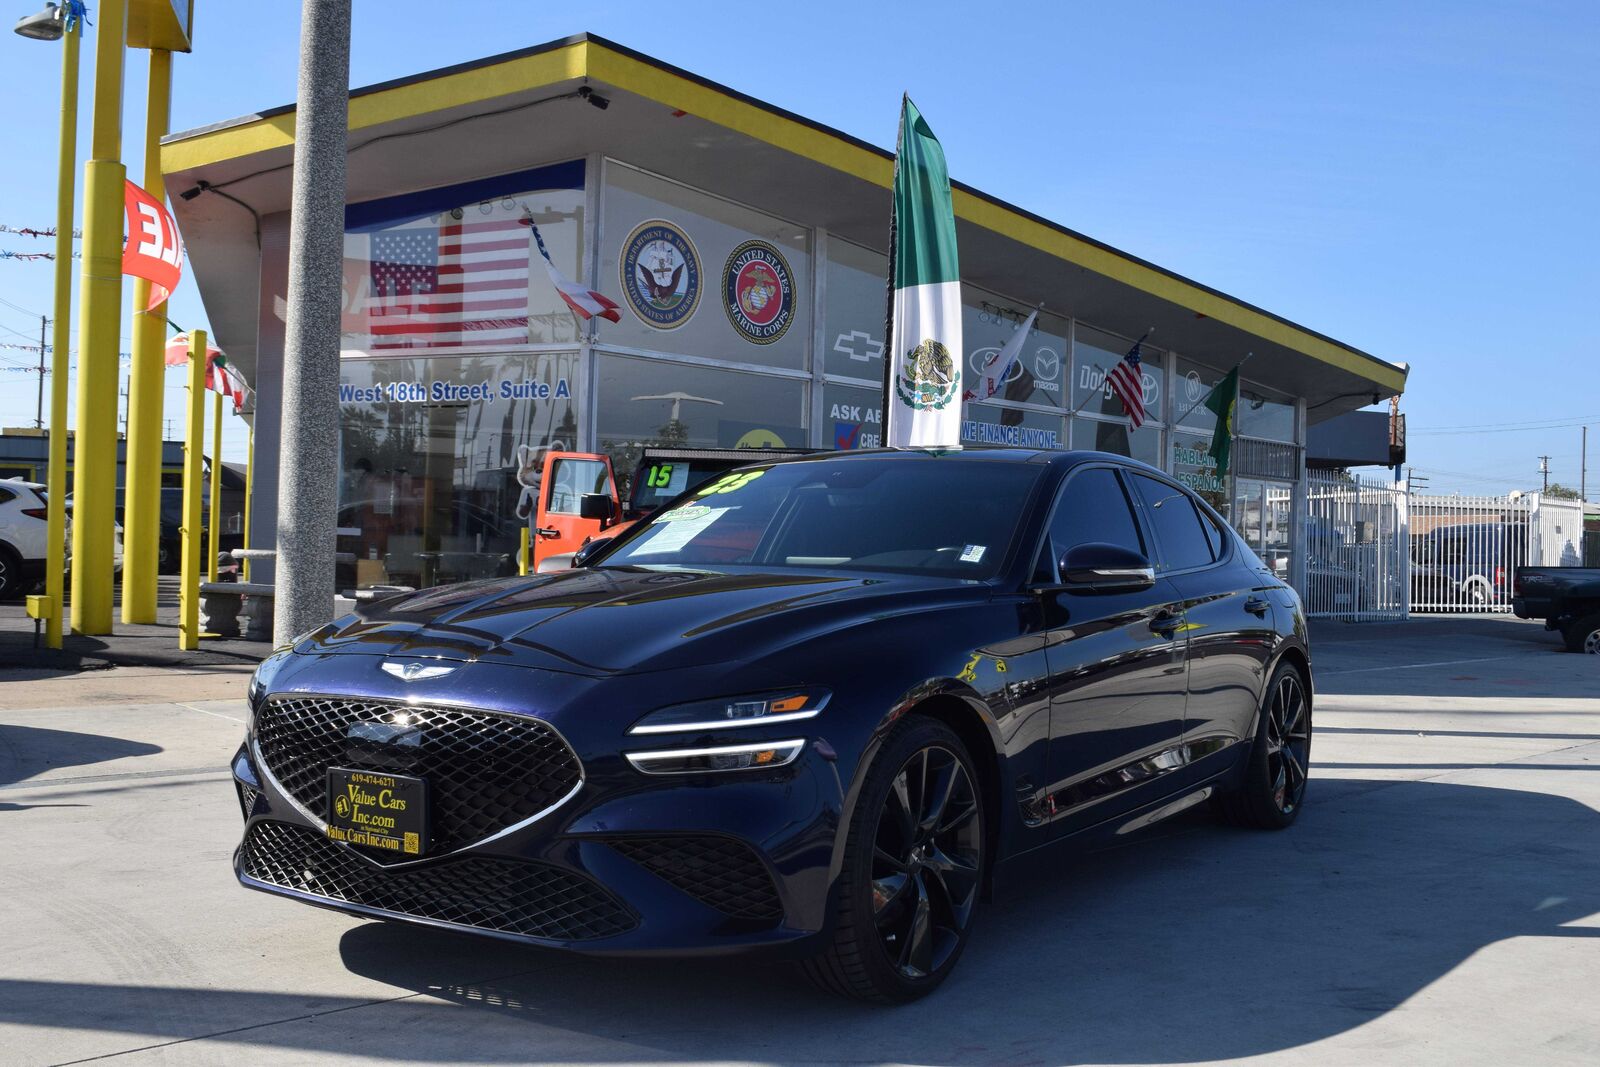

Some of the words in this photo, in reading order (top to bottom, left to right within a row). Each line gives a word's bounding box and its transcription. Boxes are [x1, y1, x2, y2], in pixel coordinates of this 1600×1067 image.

[628, 231, 662, 264] DEPARTMENT
[664, 231, 673, 240] OF
[675, 238, 687, 251] THE
[686, 252, 698, 273] NAVY
[731, 250, 764, 275] UNITED
[765, 253, 790, 294] STATES
[626, 274, 642, 306] UNITED
[640, 303, 664, 320] STATES
[665, 313, 674, 321] OF
[676, 288, 696, 316] AMERICA
[730, 301, 762, 336] MARINE
[763, 309, 789, 336] CORPS
[340, 382, 381, 402] West
[386, 382, 427, 402] 18th
[431, 381, 495, 403] Street,
[500, 379, 550, 400] Suite
[555, 379, 570, 399] A
[1033, 380, 1059, 392] mazda
[1080, 365, 1117, 400] Dodg
[830, 404, 861, 422] ASK
[961, 421, 977, 441] WE
[978, 422, 1020, 446] FINANCE
[1174, 447, 1217, 468] HABLAM
[647, 465, 672, 488] 15
[351, 773, 395, 787] 619-474-6271
[336, 797, 349, 814] #1
[347, 784, 376, 806] Value
[379, 789, 406, 811] Cars
[352, 804, 395, 829] Inc.com
